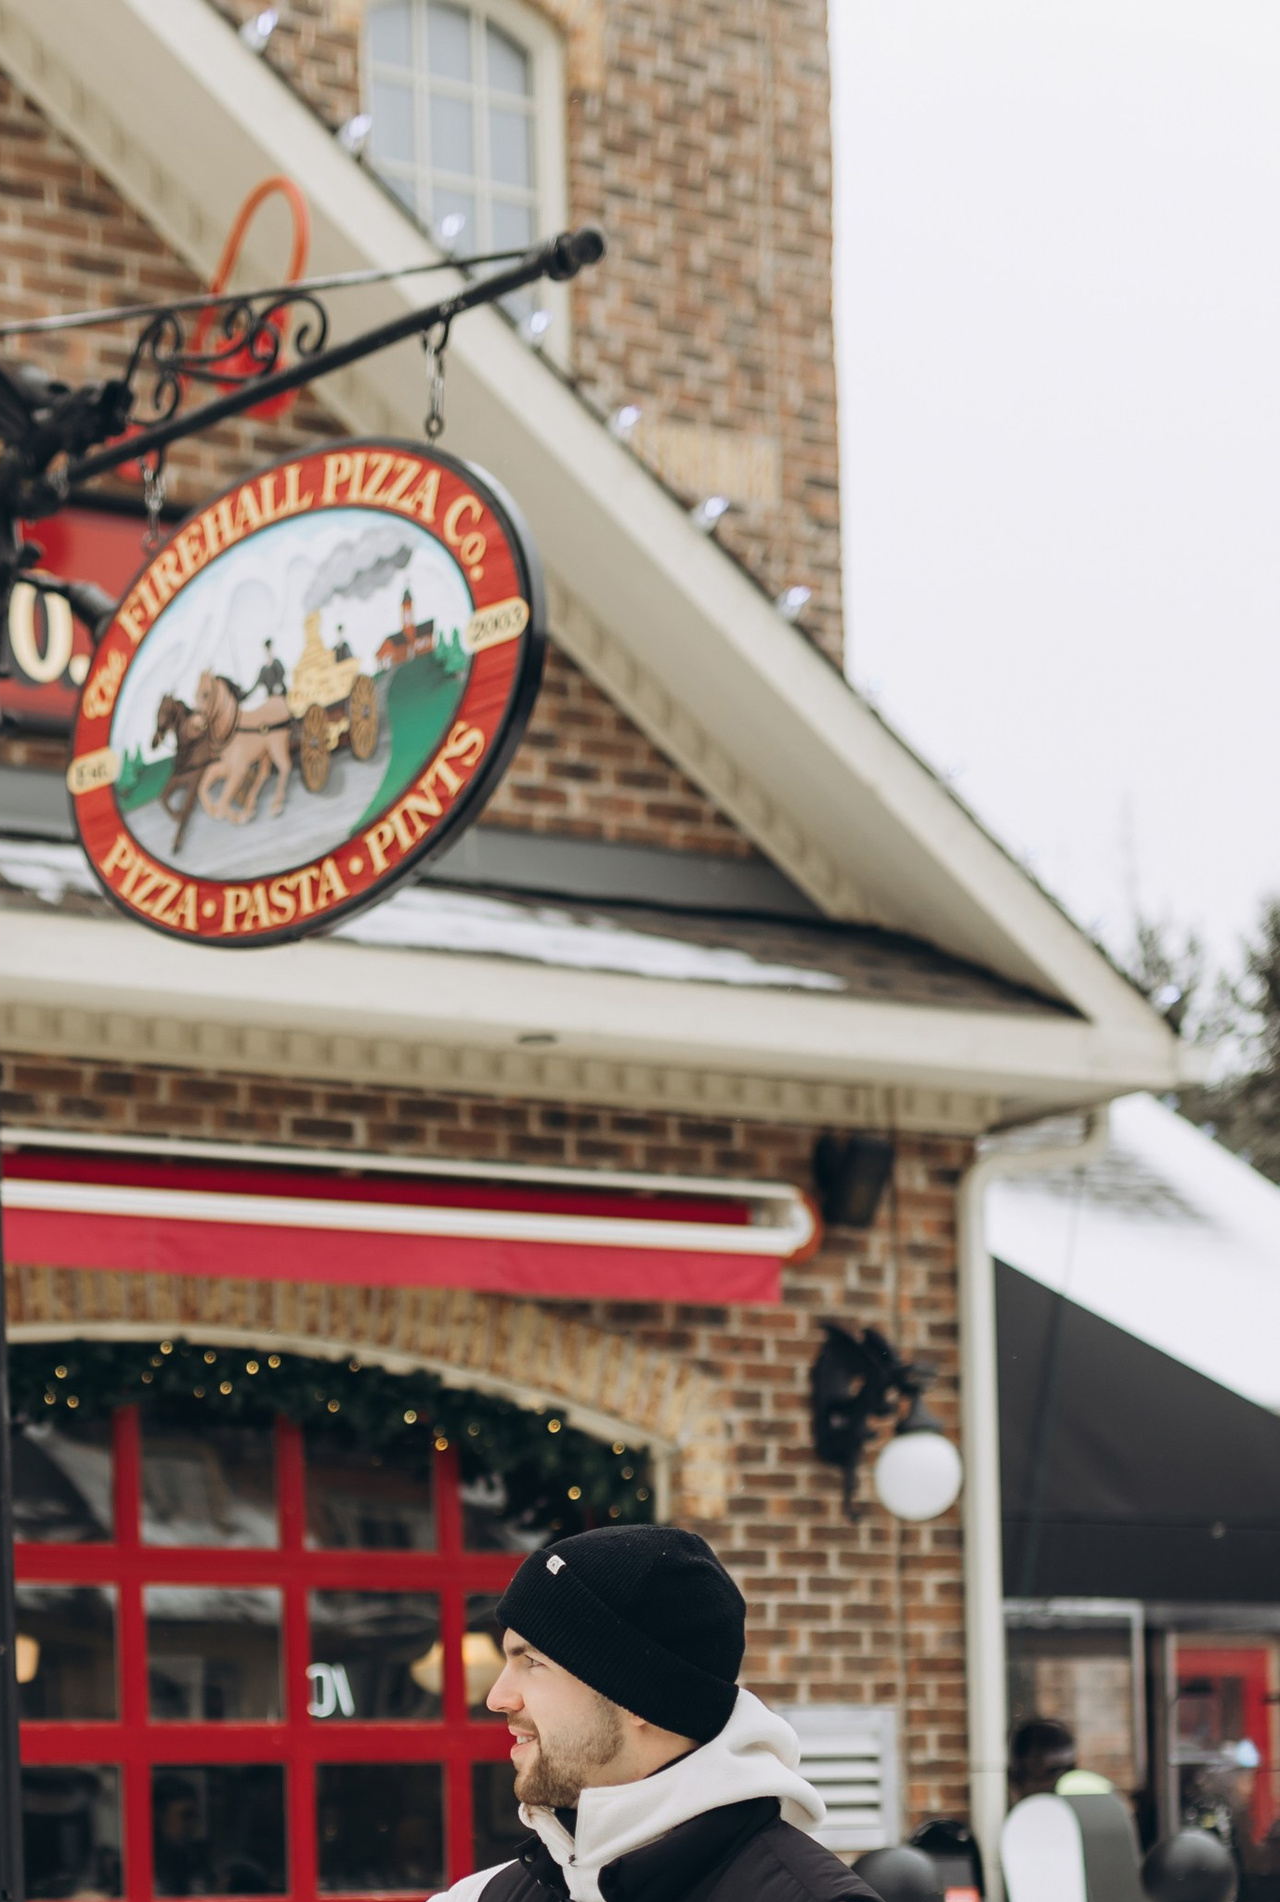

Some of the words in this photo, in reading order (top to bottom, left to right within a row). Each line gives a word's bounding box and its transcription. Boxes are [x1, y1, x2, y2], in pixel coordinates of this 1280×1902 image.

[120, 463, 314, 645] FIREHALL
[322, 451, 441, 523] PIZZA
[443, 494, 487, 582] Co.
[101, 835, 199, 931] PIZZA
[222, 857, 349, 933] PASTA
[364, 720, 486, 874] PINTS
